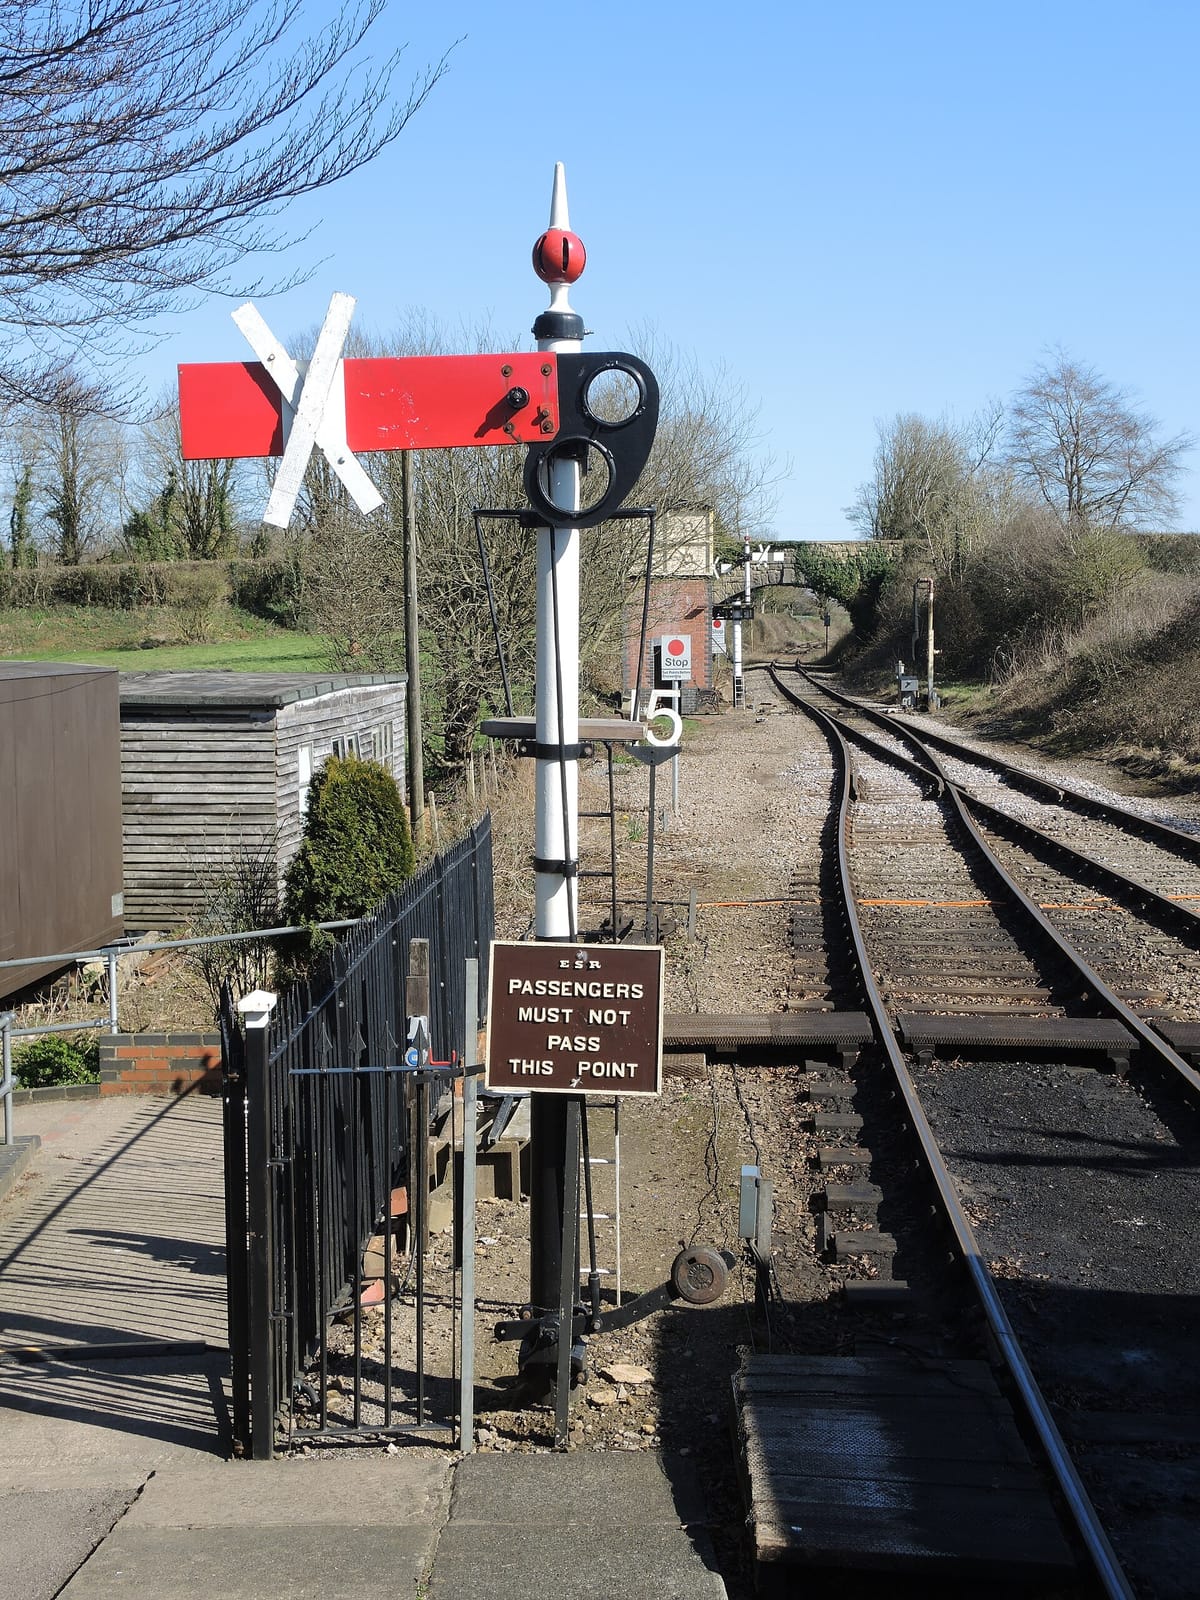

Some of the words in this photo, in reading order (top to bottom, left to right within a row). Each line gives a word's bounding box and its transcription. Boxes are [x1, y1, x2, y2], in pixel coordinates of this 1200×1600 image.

[665, 657, 689, 668] Stop
[508, 978, 644, 999] PASSENGERS
[518, 1007, 573, 1023] MUST
[589, 1009, 631, 1025] NOT
[547, 1035, 601, 1052] PASS
[508, 1058, 554, 1075] THIS
[578, 1061, 638, 1078] POINT
